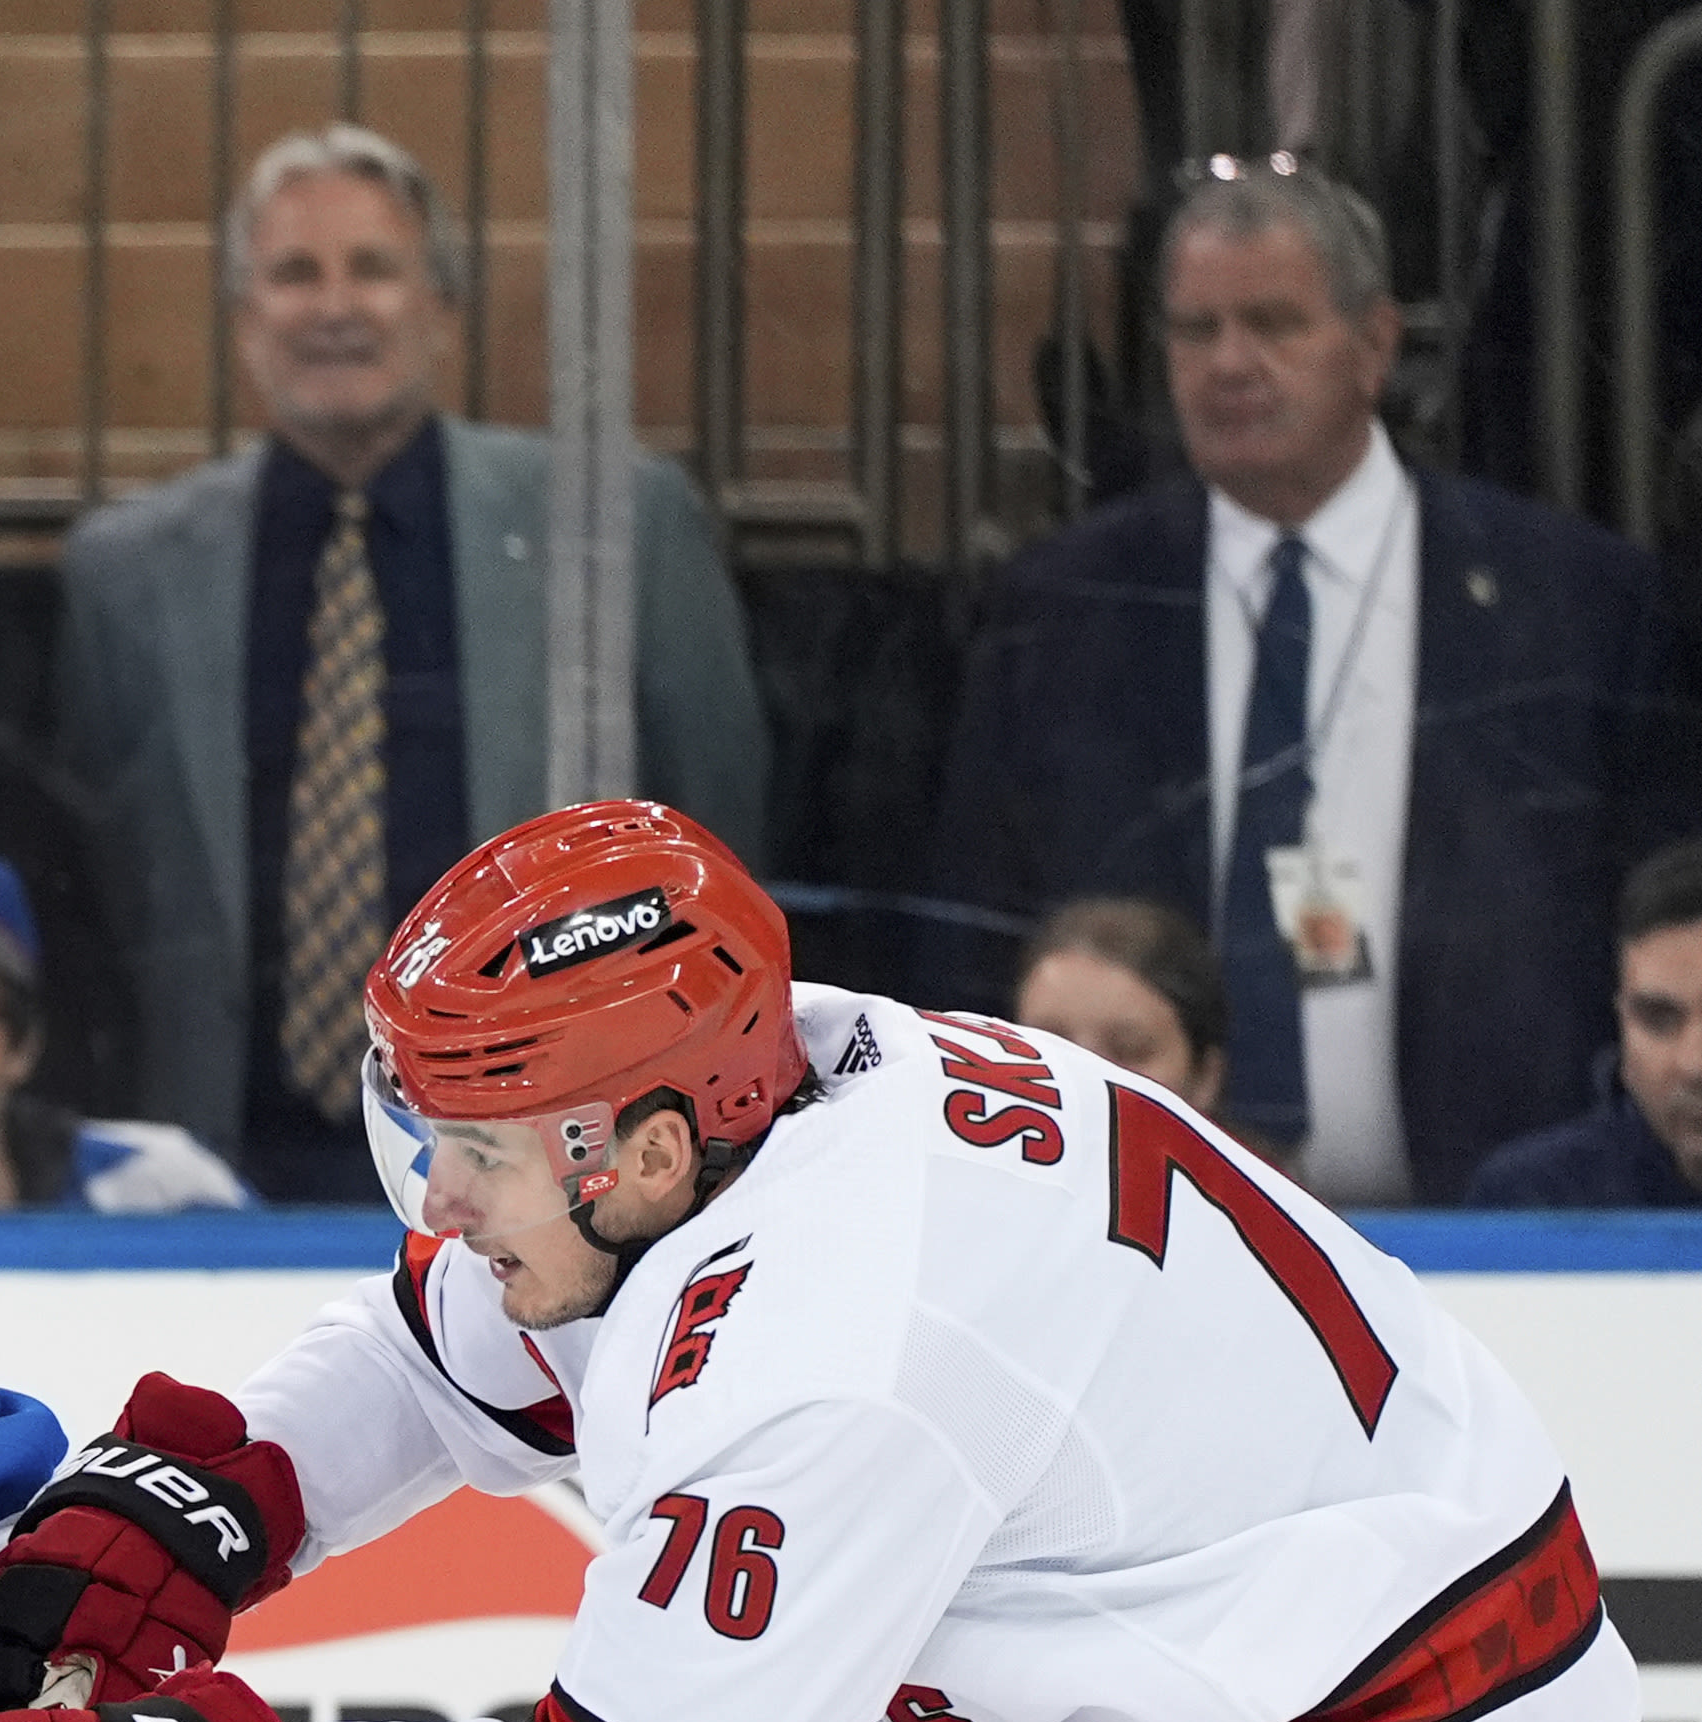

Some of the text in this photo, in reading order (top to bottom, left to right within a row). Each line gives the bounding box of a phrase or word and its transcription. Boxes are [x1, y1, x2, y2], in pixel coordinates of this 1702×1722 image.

[531, 904, 659, 965] Lenovo
[854, 1012, 882, 1068] adidas
[637, 1492, 786, 1641] 76
